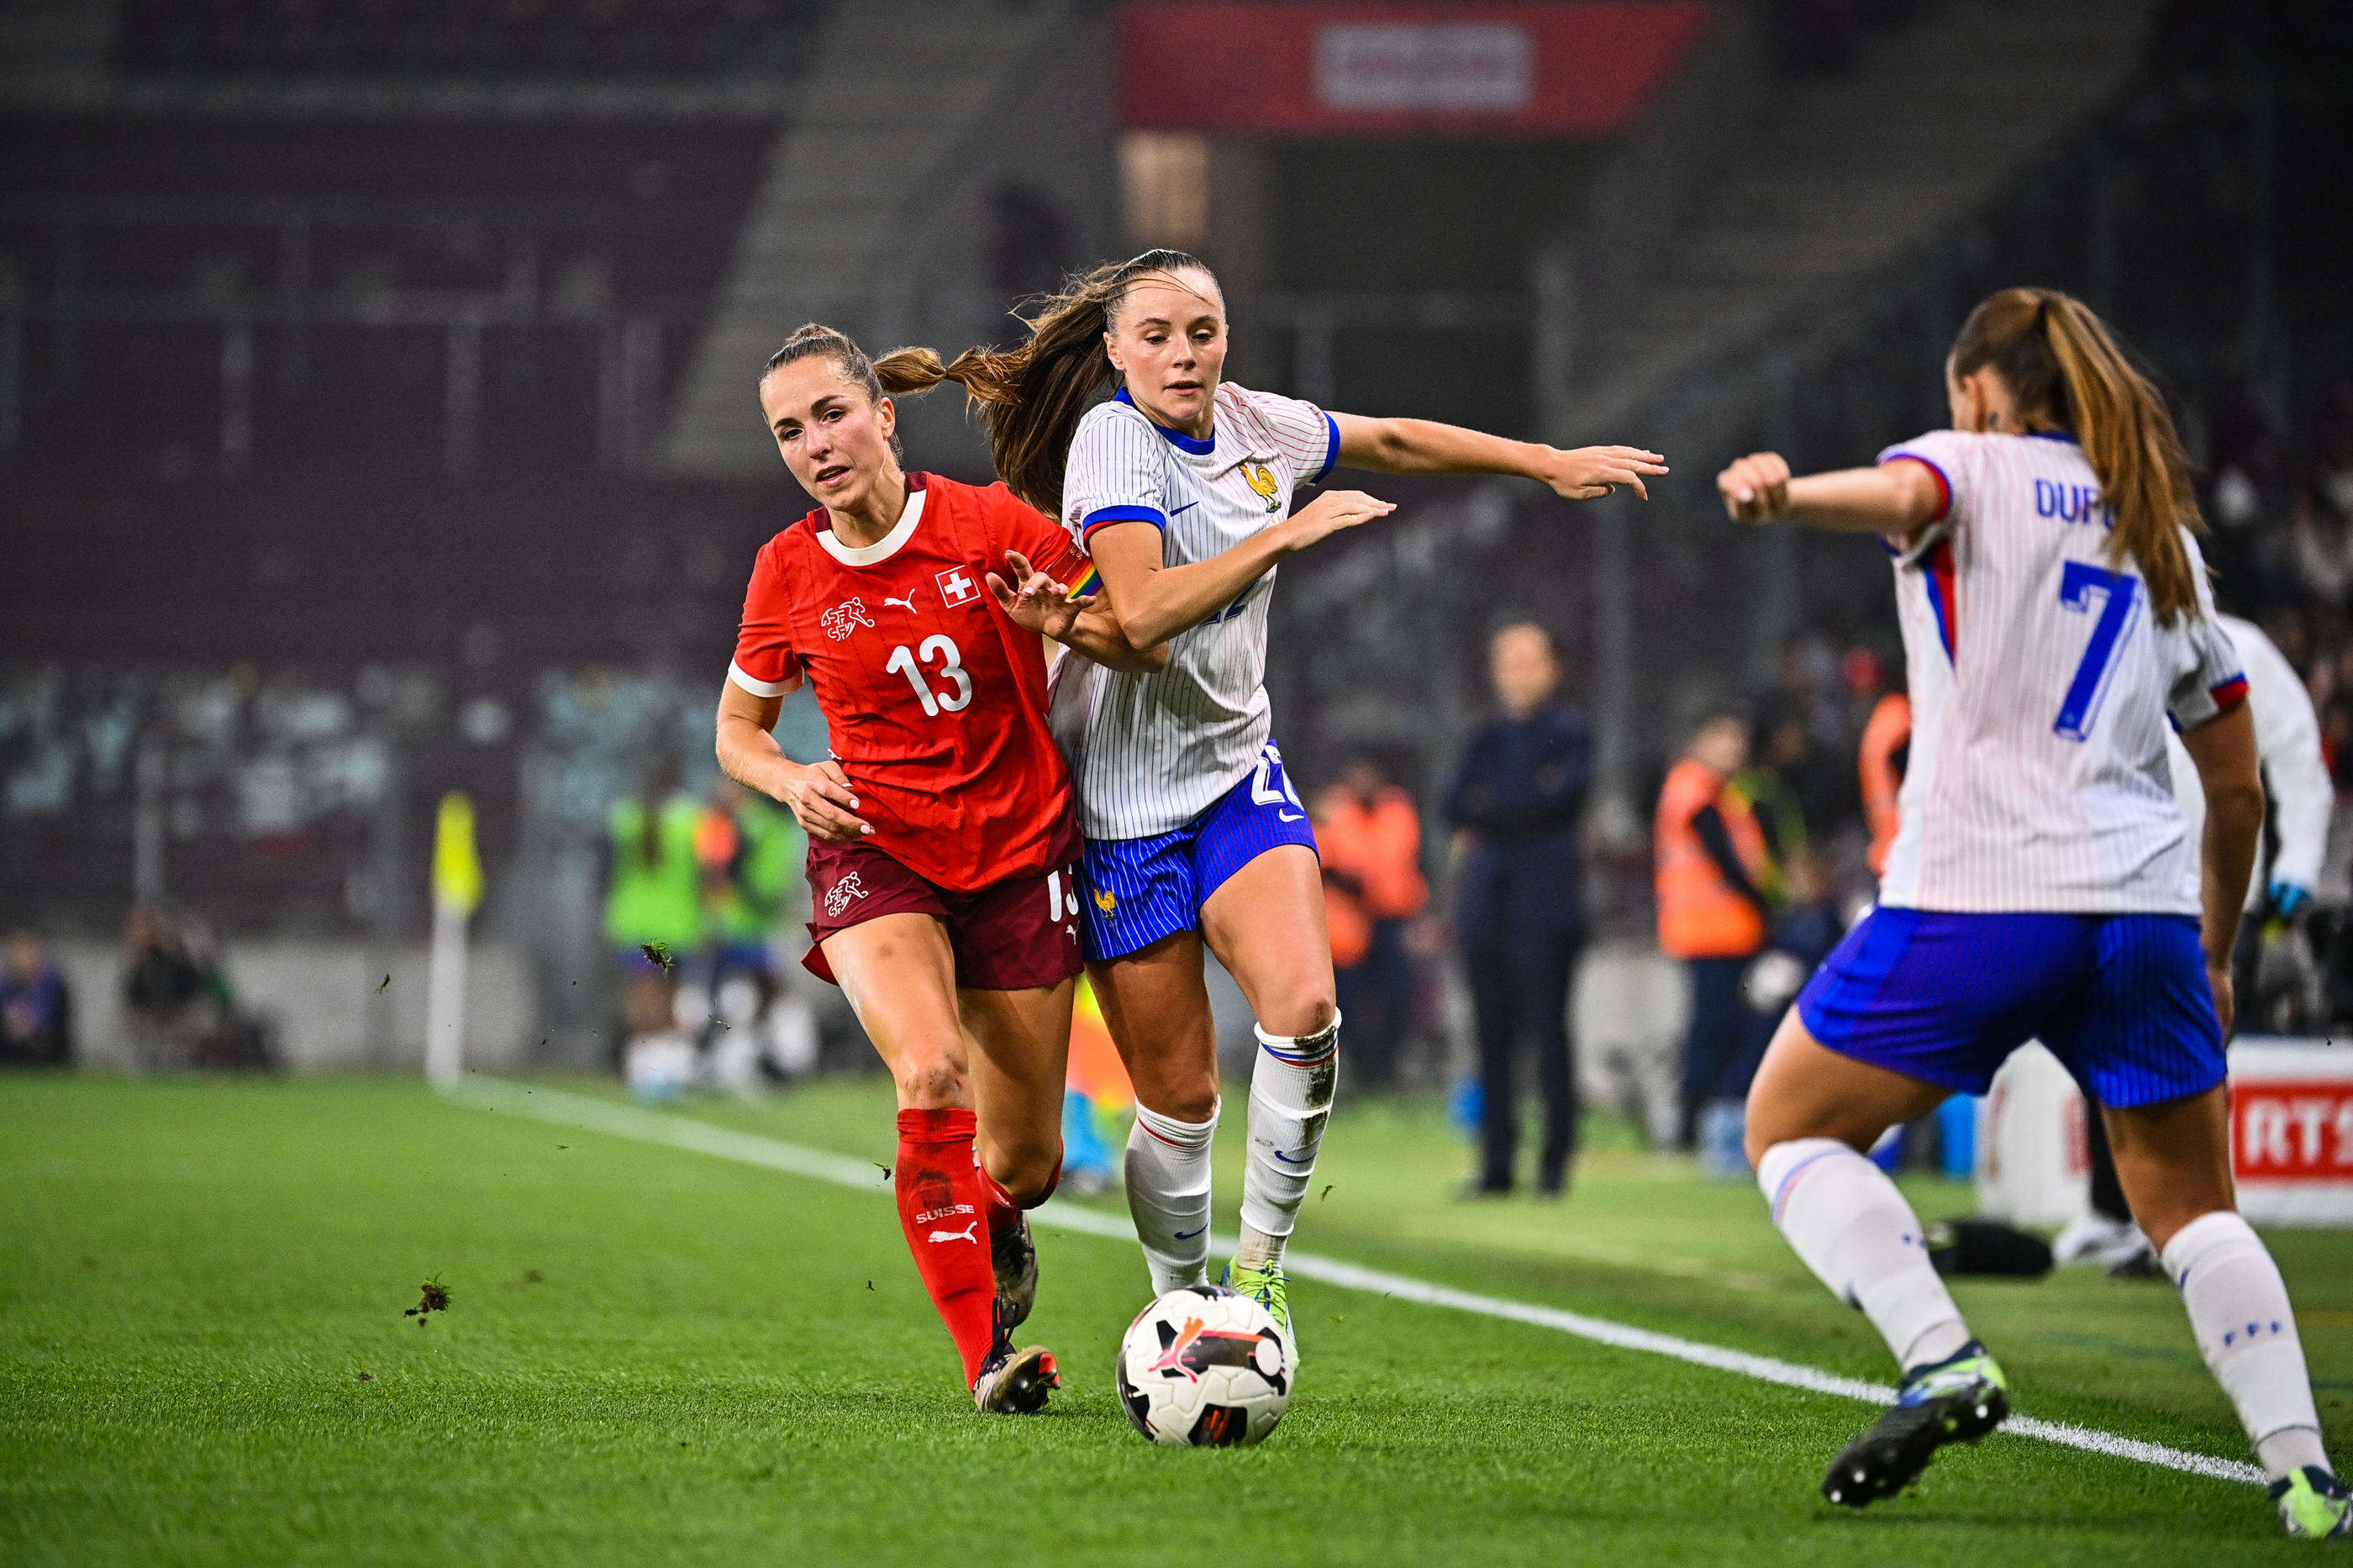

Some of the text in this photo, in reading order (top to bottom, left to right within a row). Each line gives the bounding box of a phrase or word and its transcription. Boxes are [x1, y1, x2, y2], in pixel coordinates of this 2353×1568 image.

[886, 634, 972, 717] 13
[2053, 559, 2142, 743] 7
[916, 1204, 975, 1224] SUISSE
